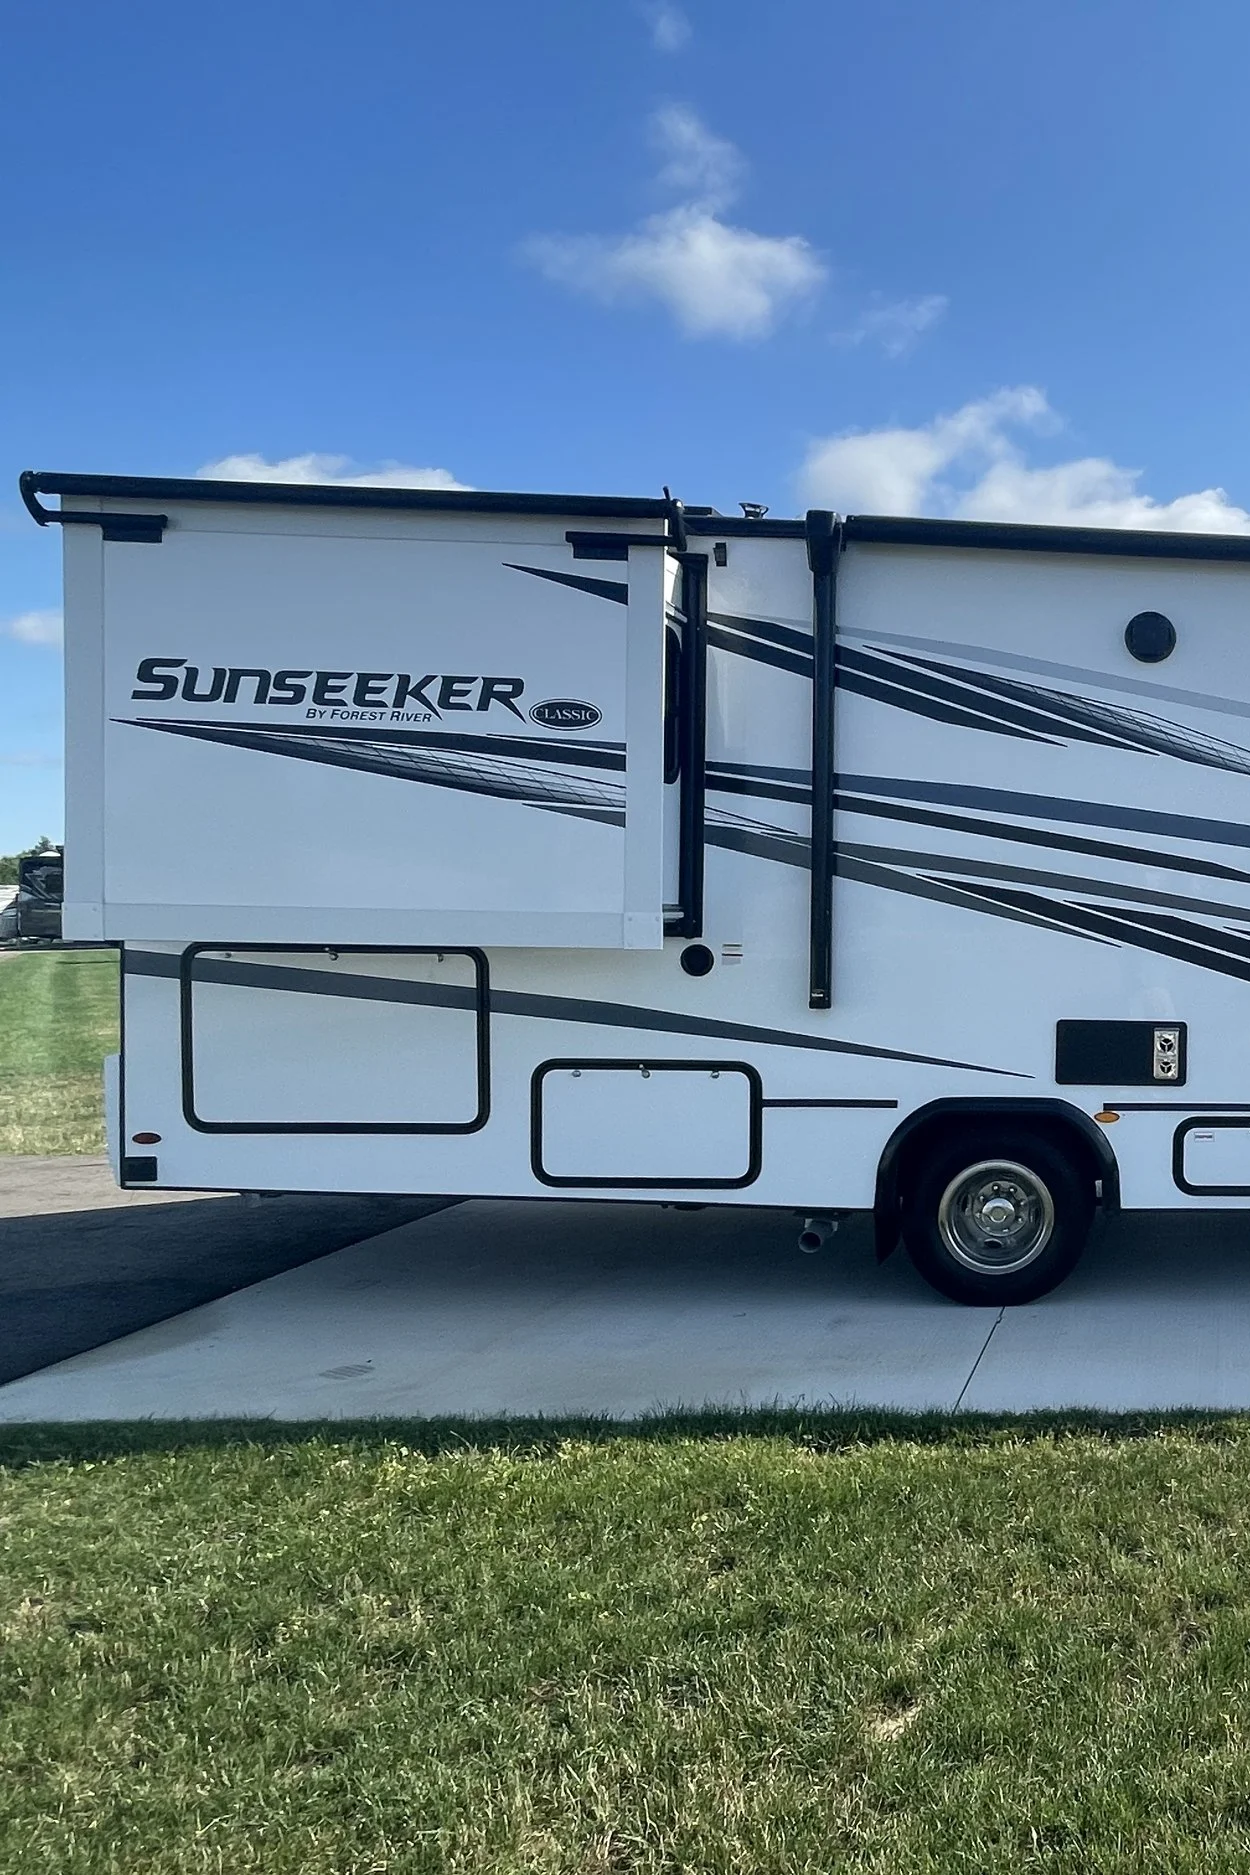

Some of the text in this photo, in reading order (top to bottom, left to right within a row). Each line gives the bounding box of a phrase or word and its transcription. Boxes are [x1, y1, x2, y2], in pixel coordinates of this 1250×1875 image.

[131, 657, 527, 724] SUNSEEKER
[330, 708, 387, 721] FOREST
[389, 710, 433, 722] RIVER
[533, 708, 598, 721] CLASSIC
